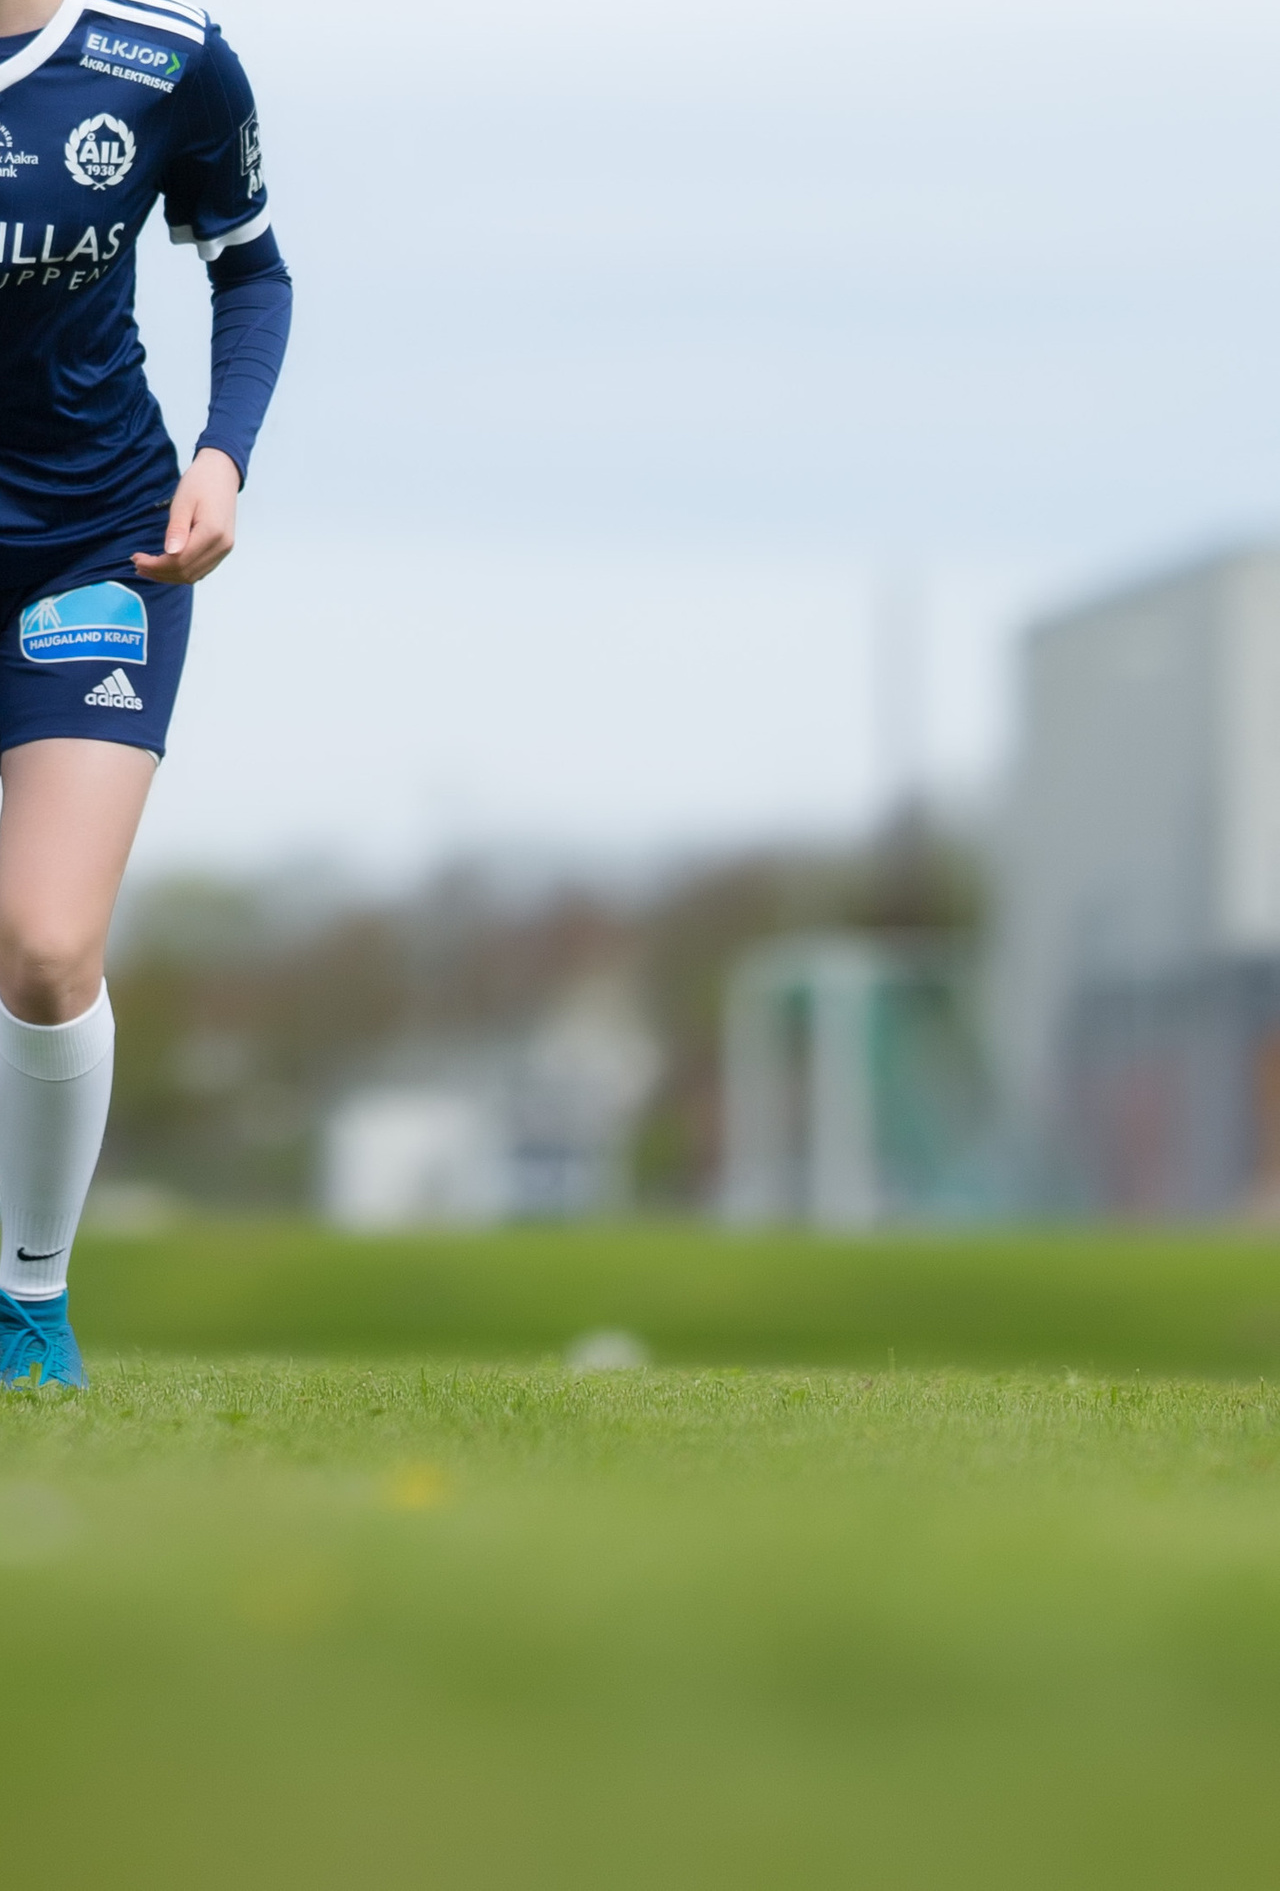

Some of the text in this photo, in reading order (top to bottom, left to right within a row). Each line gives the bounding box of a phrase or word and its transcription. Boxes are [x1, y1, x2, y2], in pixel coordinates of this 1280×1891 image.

[80, 55, 175, 94] ÅKRA ELEKTRISKE
[79, 132, 125, 164] ÅIL
[4, 151, 39, 165] Aakra
[85, 164, 116, 177] 1938
[29, 631, 142, 651] HAUGALAND KRAFT
[84, 692, 144, 711] adidas
